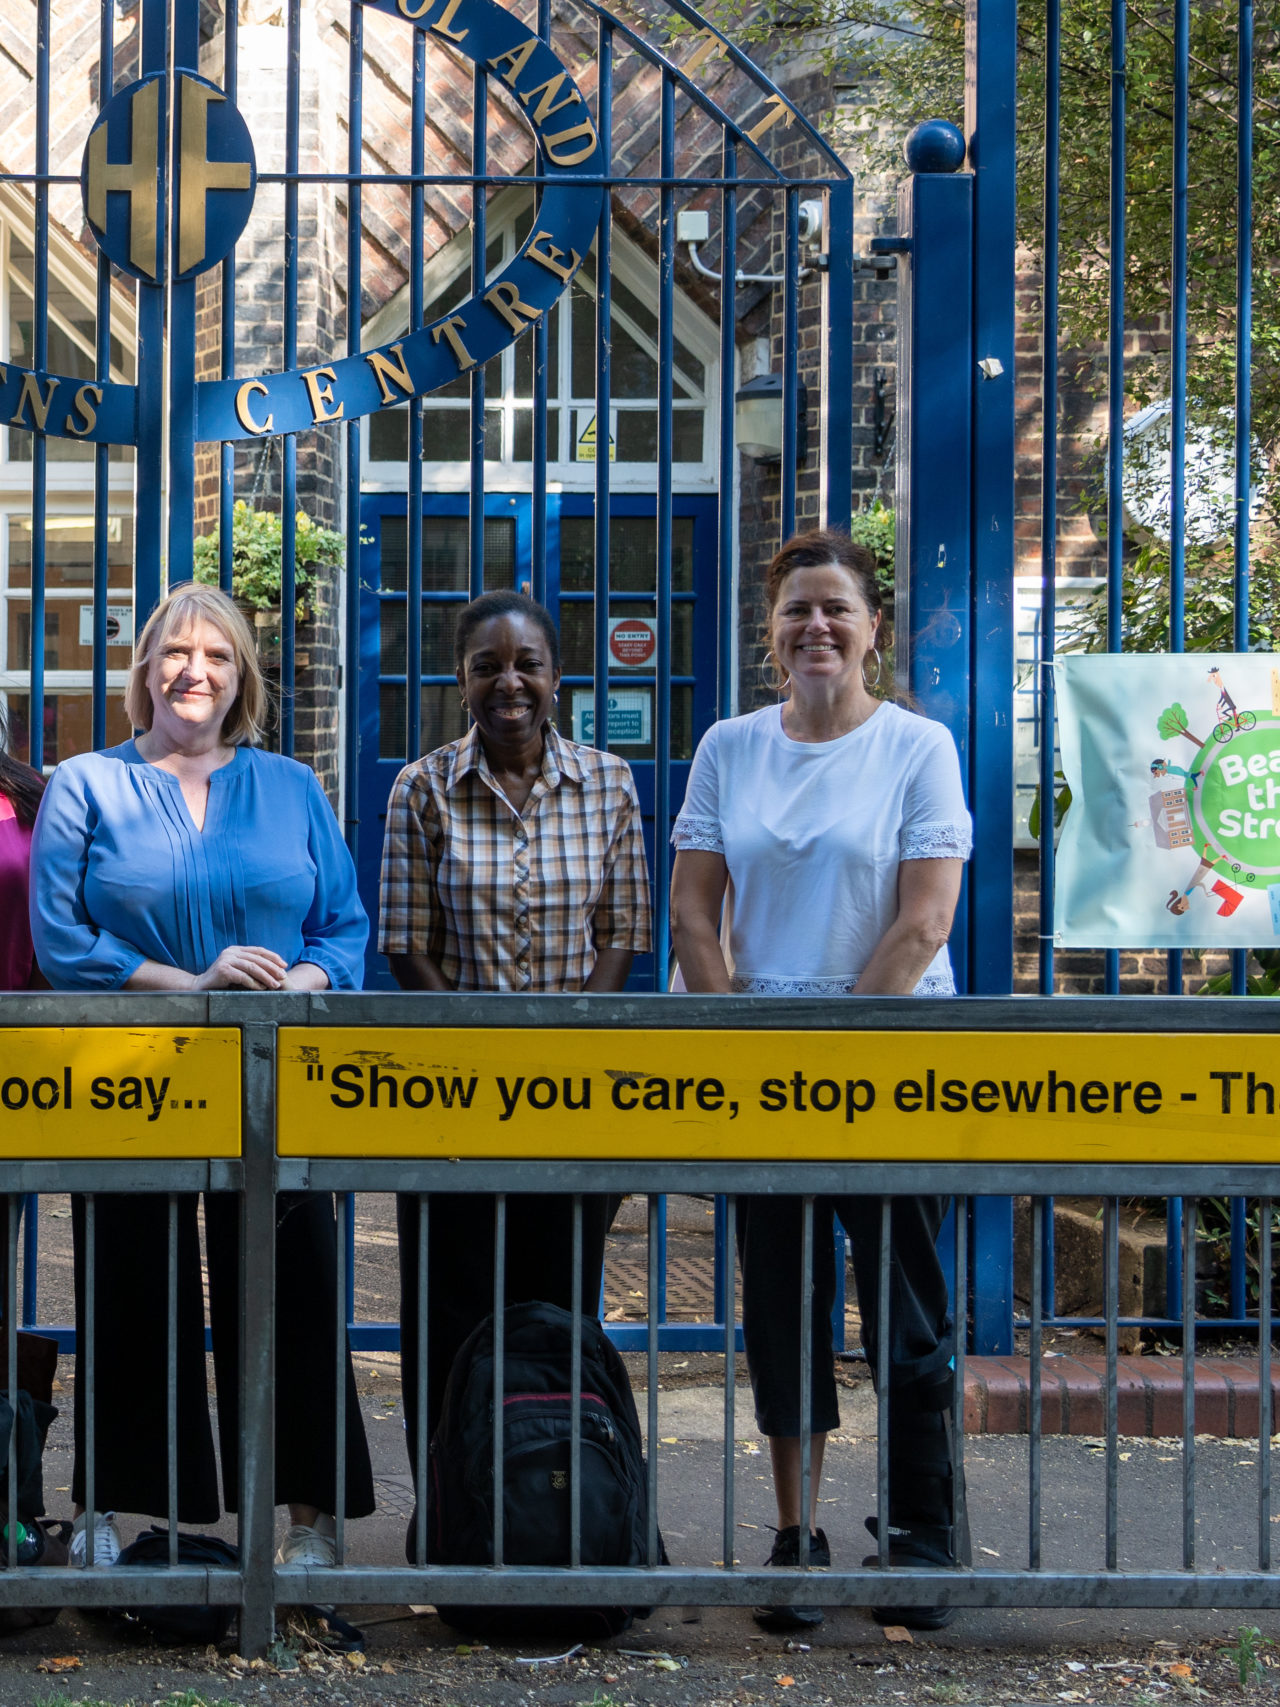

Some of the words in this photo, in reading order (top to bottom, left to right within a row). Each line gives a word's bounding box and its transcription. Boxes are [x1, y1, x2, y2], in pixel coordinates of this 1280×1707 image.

[487, 35, 599, 167] AND
[235, 230, 583, 436] CENTRE
[607, 728, 640, 736] eception
[90, 1075, 208, 1122] say...
[306, 1063, 479, 1109] "Show
[497, 1075, 592, 1122] you
[610, 1076, 740, 1120] care,
[759, 1071, 877, 1124] stop
[893, 1069, 1163, 1115] elsewhere
